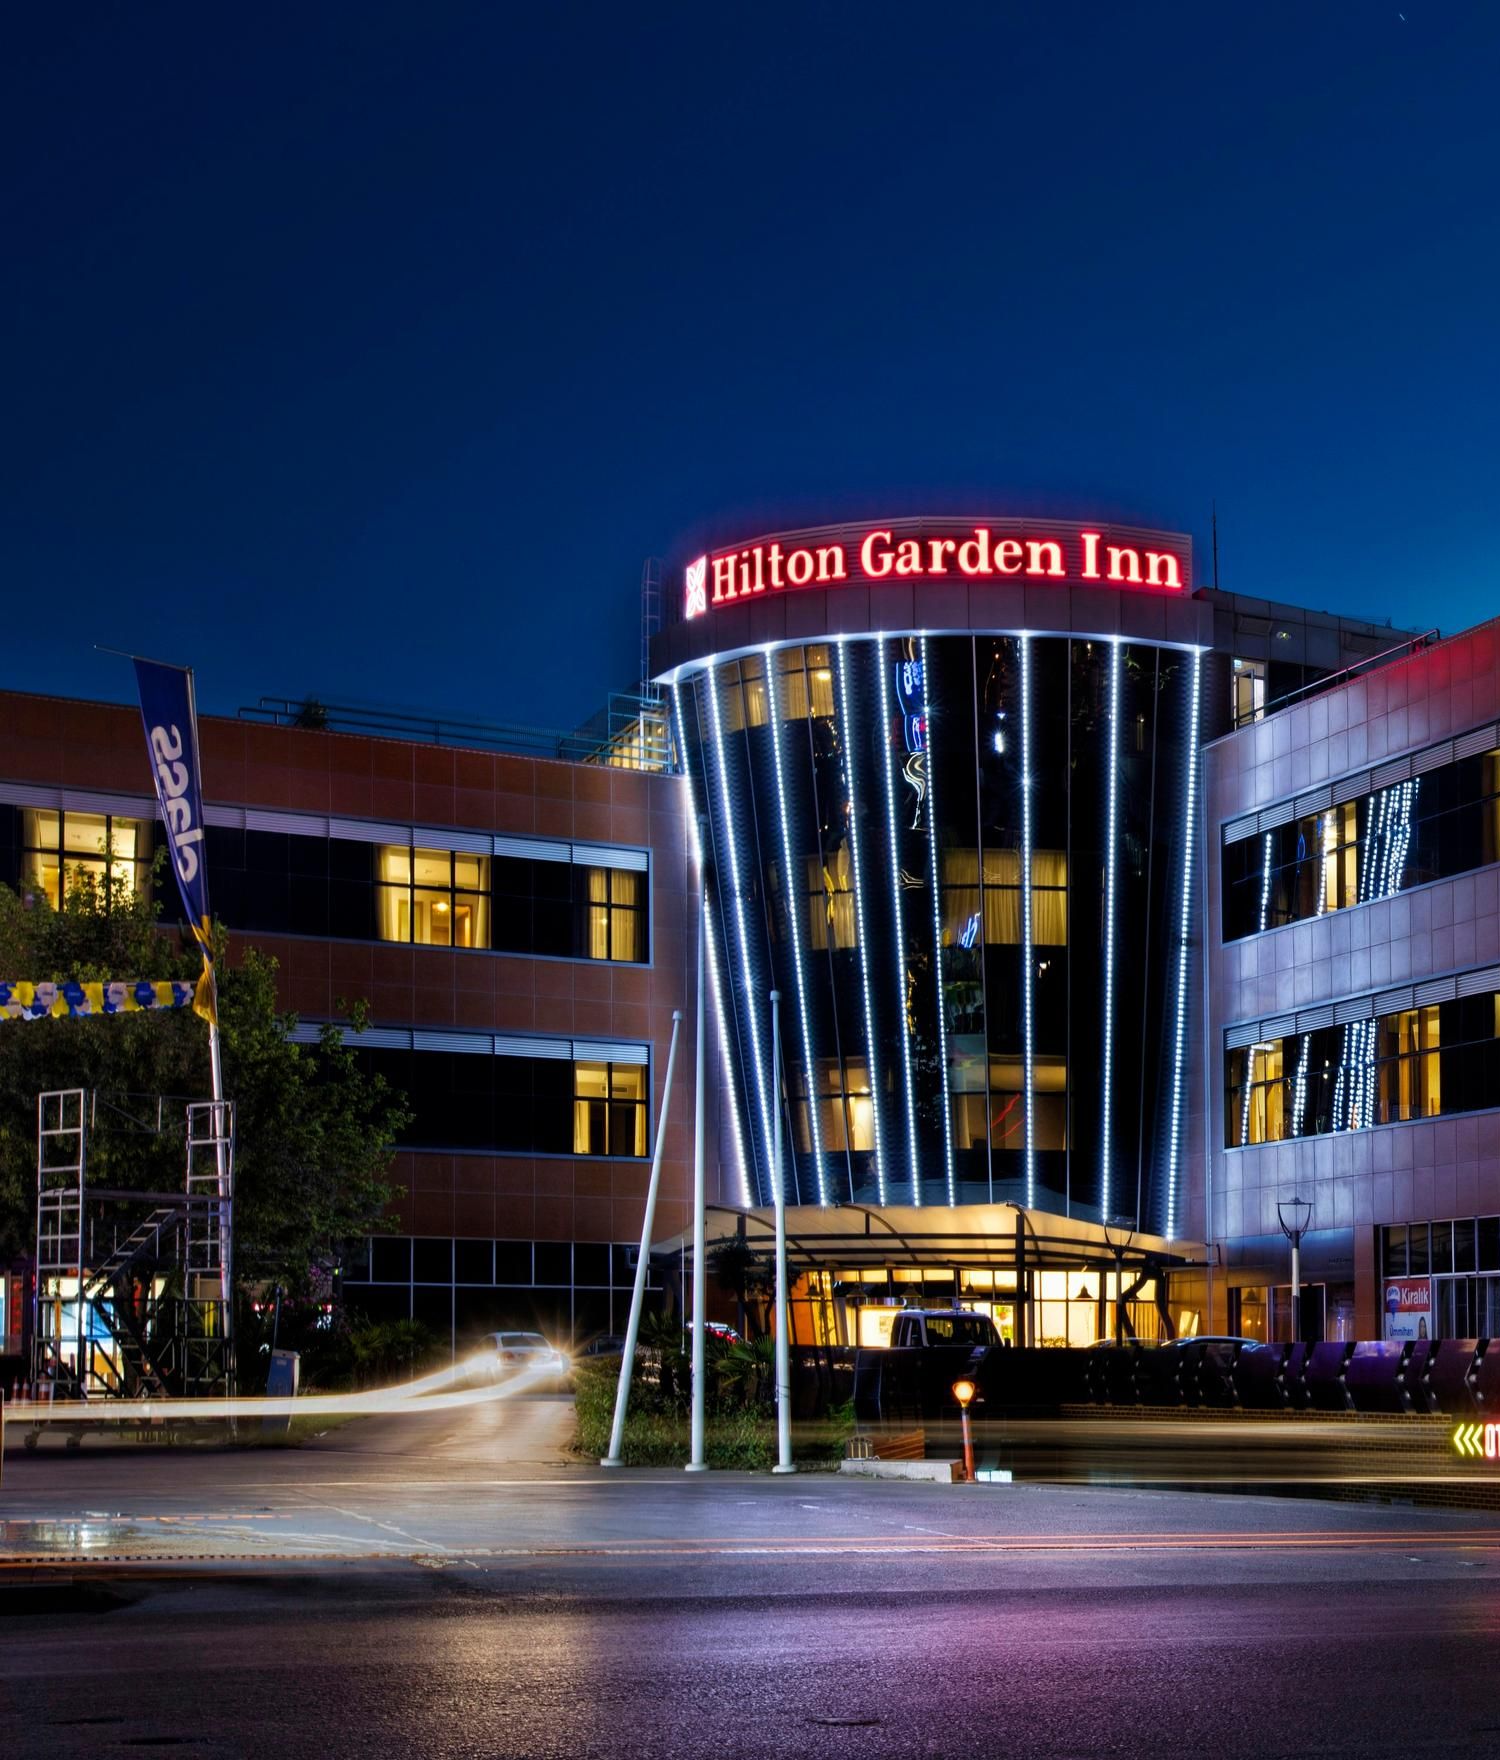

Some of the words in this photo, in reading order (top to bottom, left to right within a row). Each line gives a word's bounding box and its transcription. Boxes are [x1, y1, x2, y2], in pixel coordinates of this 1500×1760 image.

[711, 543, 847, 604] Hilton
[861, 529, 1066, 577] Garden
[1081, 532, 1182, 588] Inn
